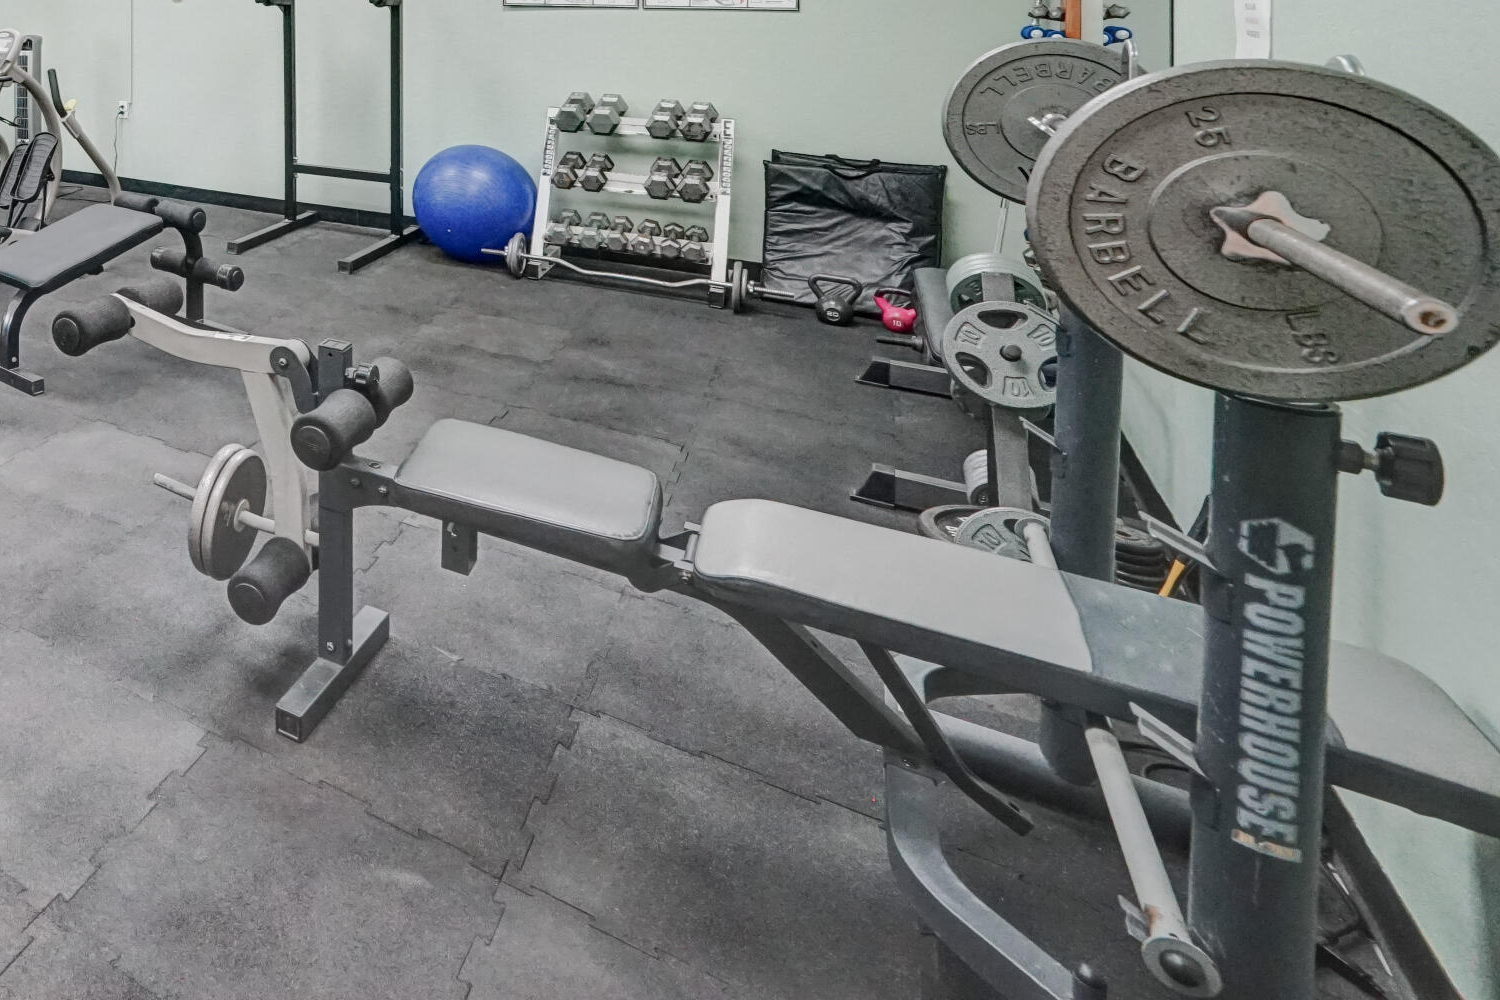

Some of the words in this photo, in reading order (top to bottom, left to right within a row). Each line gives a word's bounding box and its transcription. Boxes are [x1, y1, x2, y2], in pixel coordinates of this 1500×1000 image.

[979, 61, 1116, 97] BARBELL
[965, 121, 1000, 136] LBS
[1185, 106, 1232, 148] 25
[1083, 153, 1213, 345] BARBELL
[892, 319, 902, 328] 10
[1285, 311, 1341, 365] LBS
[1237, 571, 1305, 845] POWERHOUSE
